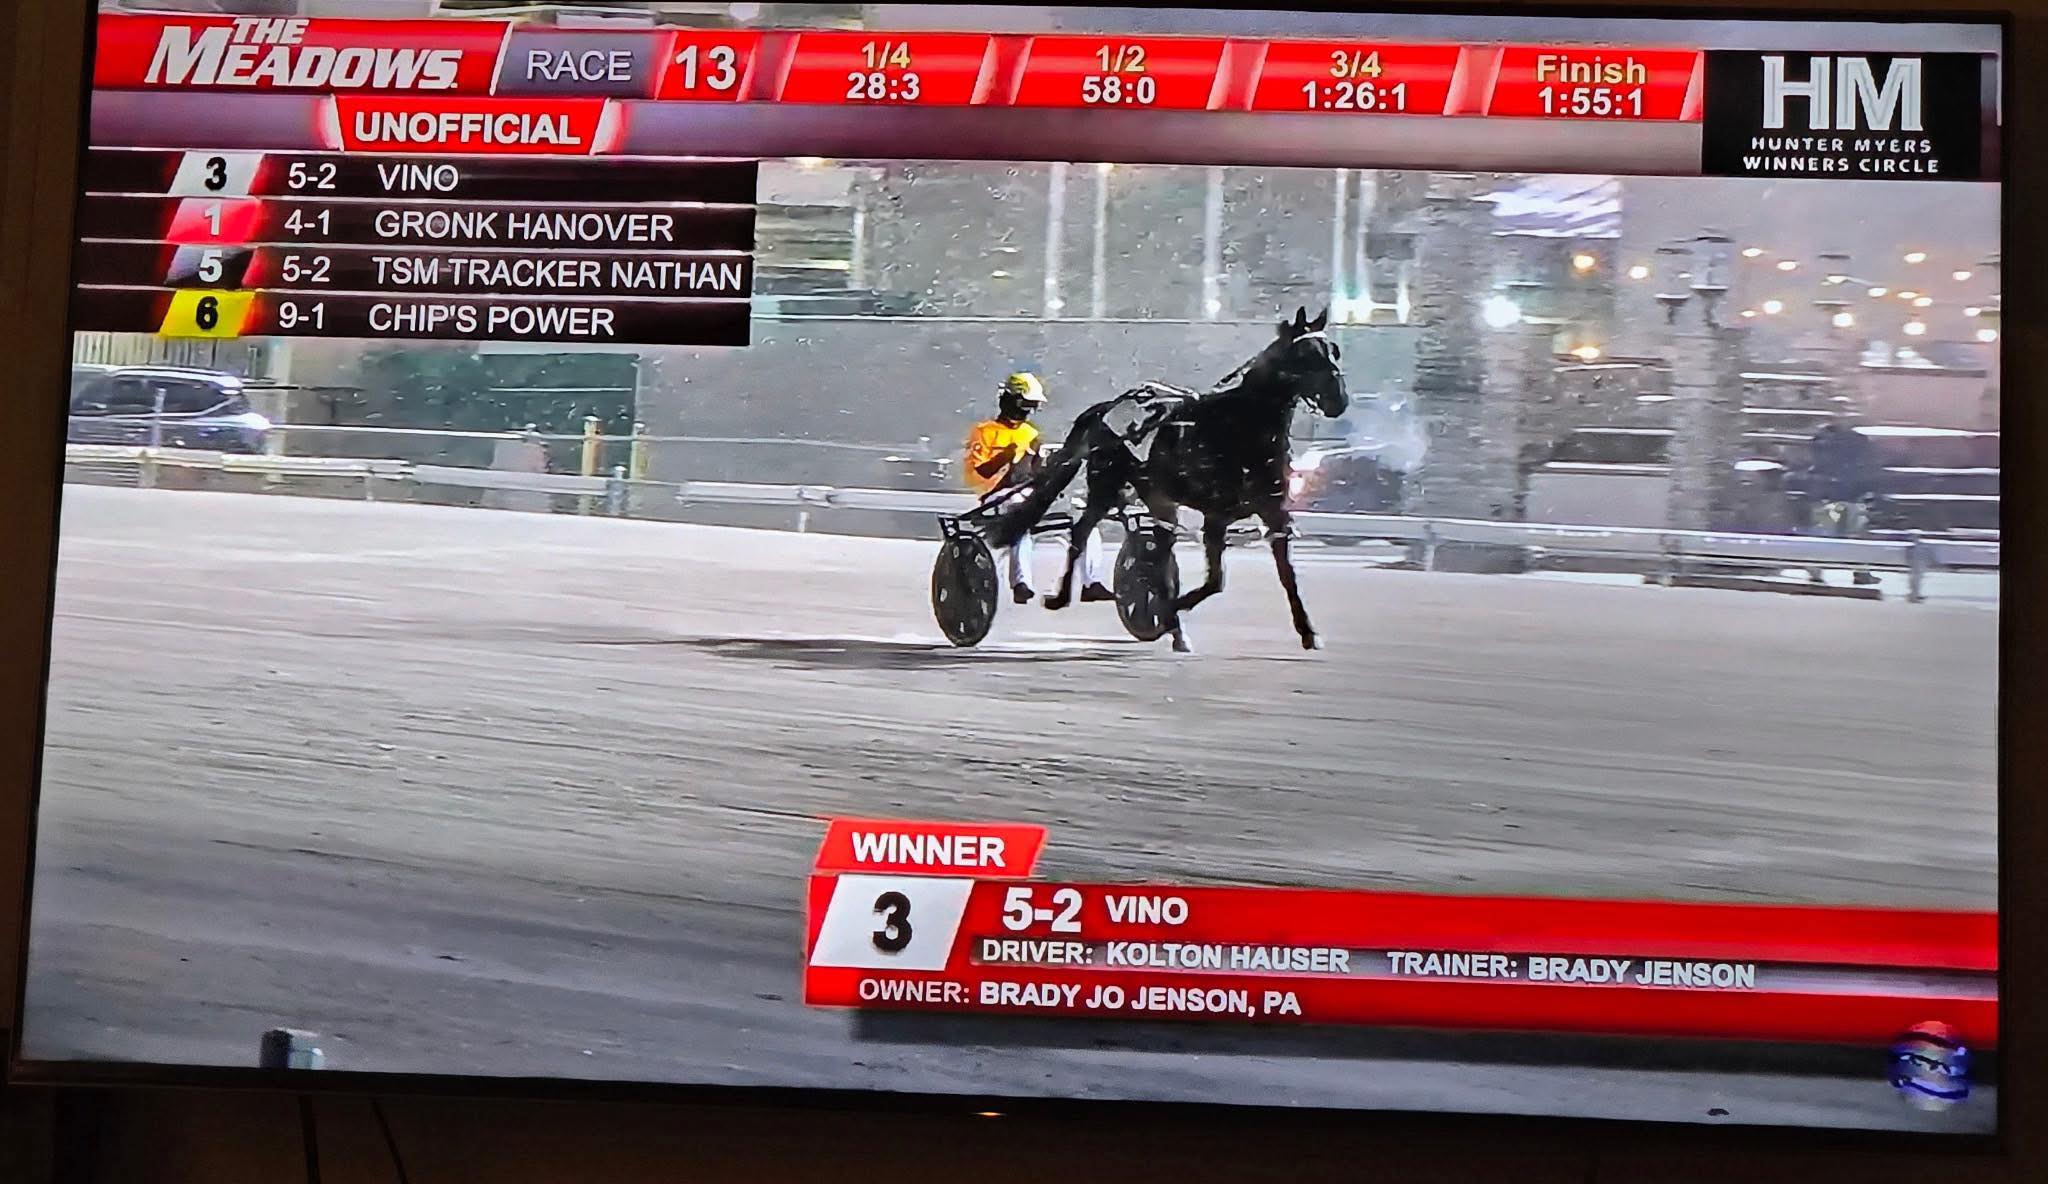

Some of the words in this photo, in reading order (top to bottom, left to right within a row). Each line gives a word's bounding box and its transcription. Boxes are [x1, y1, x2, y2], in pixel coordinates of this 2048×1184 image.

[229, 17, 309, 46] THE
[526, 49, 633, 81] RACE
[675, 46, 737, 89] 13
[861, 42, 910, 69] 1/4
[1096, 46, 1145, 73] 1/2
[1329, 51, 1382, 79] 3/4
[1536, 55, 1646, 84] Finish
[846, 73, 920, 100] 28:3
[1081, 76, 1156, 104] 58:0
[1302, 82, 1407, 111] 1:26:1
[1539, 88, 1643, 116] 1:55:1
[1761, 55, 1923, 132] HM
[355, 112, 580, 145] UNOFFICIAL
[1751, 137, 1843, 152] HUNTER
[1854, 138, 1931, 154] MYERS
[204, 157, 227, 190] 3
[288, 163, 336, 189] 5-2
[377, 163, 459, 191] VINO
[1742, 156, 1849, 173] WINNERS
[1858, 157, 1939, 174] CIRCLE
[204, 206, 222, 235] 1
[284, 210, 331, 235] 4-1
[374, 210, 498, 240] GRONK
[508, 213, 673, 242] HANOVER
[199, 250, 223, 282] 5
[281, 256, 331, 283] 5-2
[372, 257, 440, 284] TSM
[448, 259, 601, 287] TRACKER
[610, 262, 742, 290] NATHAN
[195, 296, 218, 330] 6
[278, 303, 325, 330] 9-1
[368, 304, 478, 333] CHIP'S
[488, 307, 614, 336] POWER
[852, 832, 1006, 868] WINNER
[872, 891, 913, 953] 3
[1002, 887, 1083, 933] 5-2
[1105, 895, 1189, 925] VINO
[982, 939, 1094, 965] DRIVER:
[1107, 942, 1221, 969] KOLTON
[1229, 946, 1350, 973] HAUSER
[1387, 952, 1517, 979] TRAINER:
[1528, 956, 1631, 984] BRADY
[1635, 960, 1755, 989] JENSON
[859, 979, 970, 1003] OWNER:
[980, 981, 1080, 1009] BRADY
[1086, 984, 1125, 1010] JO
[1131, 985, 1256, 1017] JENSON,
[1264, 990, 1302, 1016] PA
